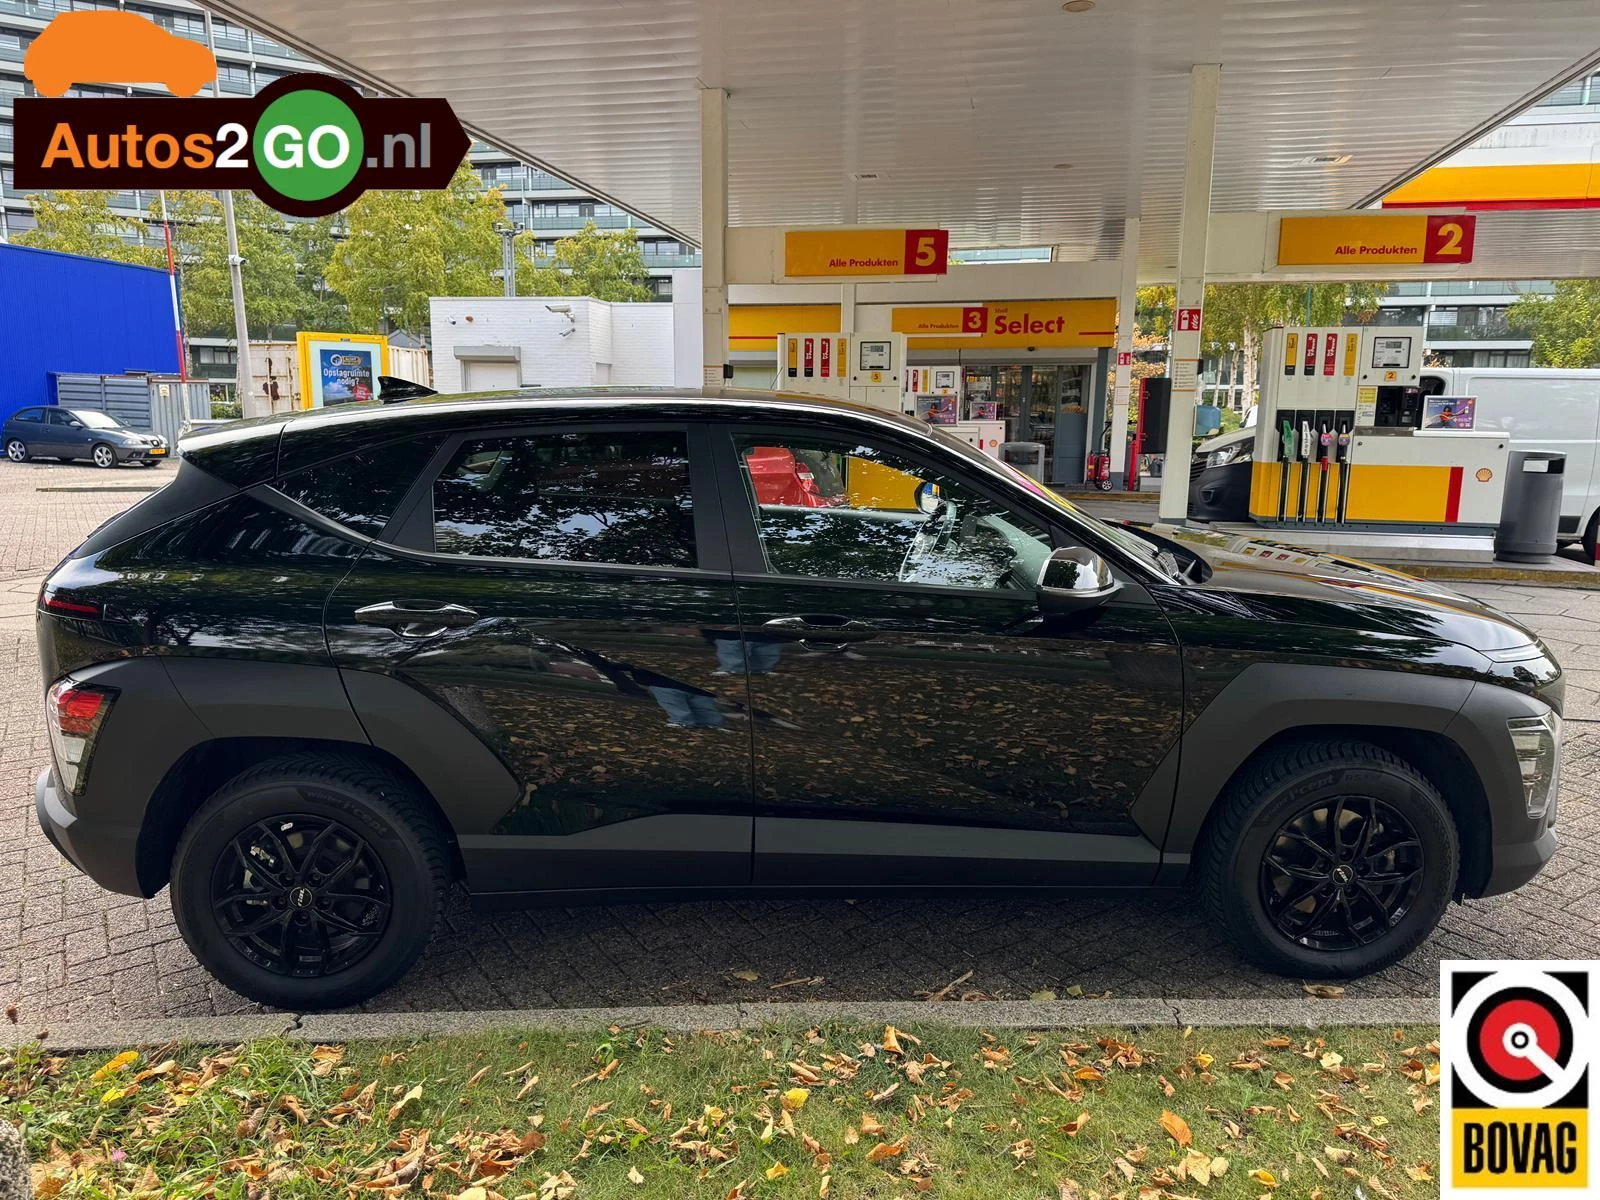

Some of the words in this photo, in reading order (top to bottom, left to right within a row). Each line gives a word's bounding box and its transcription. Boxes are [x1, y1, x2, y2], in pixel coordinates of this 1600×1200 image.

[1435, 223, 1464, 255] 2
[915, 236, 937, 267] 5
[1335, 245, 1356, 255] Alle
[1359, 244, 1418, 255] Produkten
[828, 258, 847, 268] Alle
[849, 257, 898, 267] Produkten
[968, 311, 982, 329] 3
[993, 313, 1065, 335] Select
[323, 368, 370, 378] Opslagruimte
[336, 377, 360, 386] nodig?
